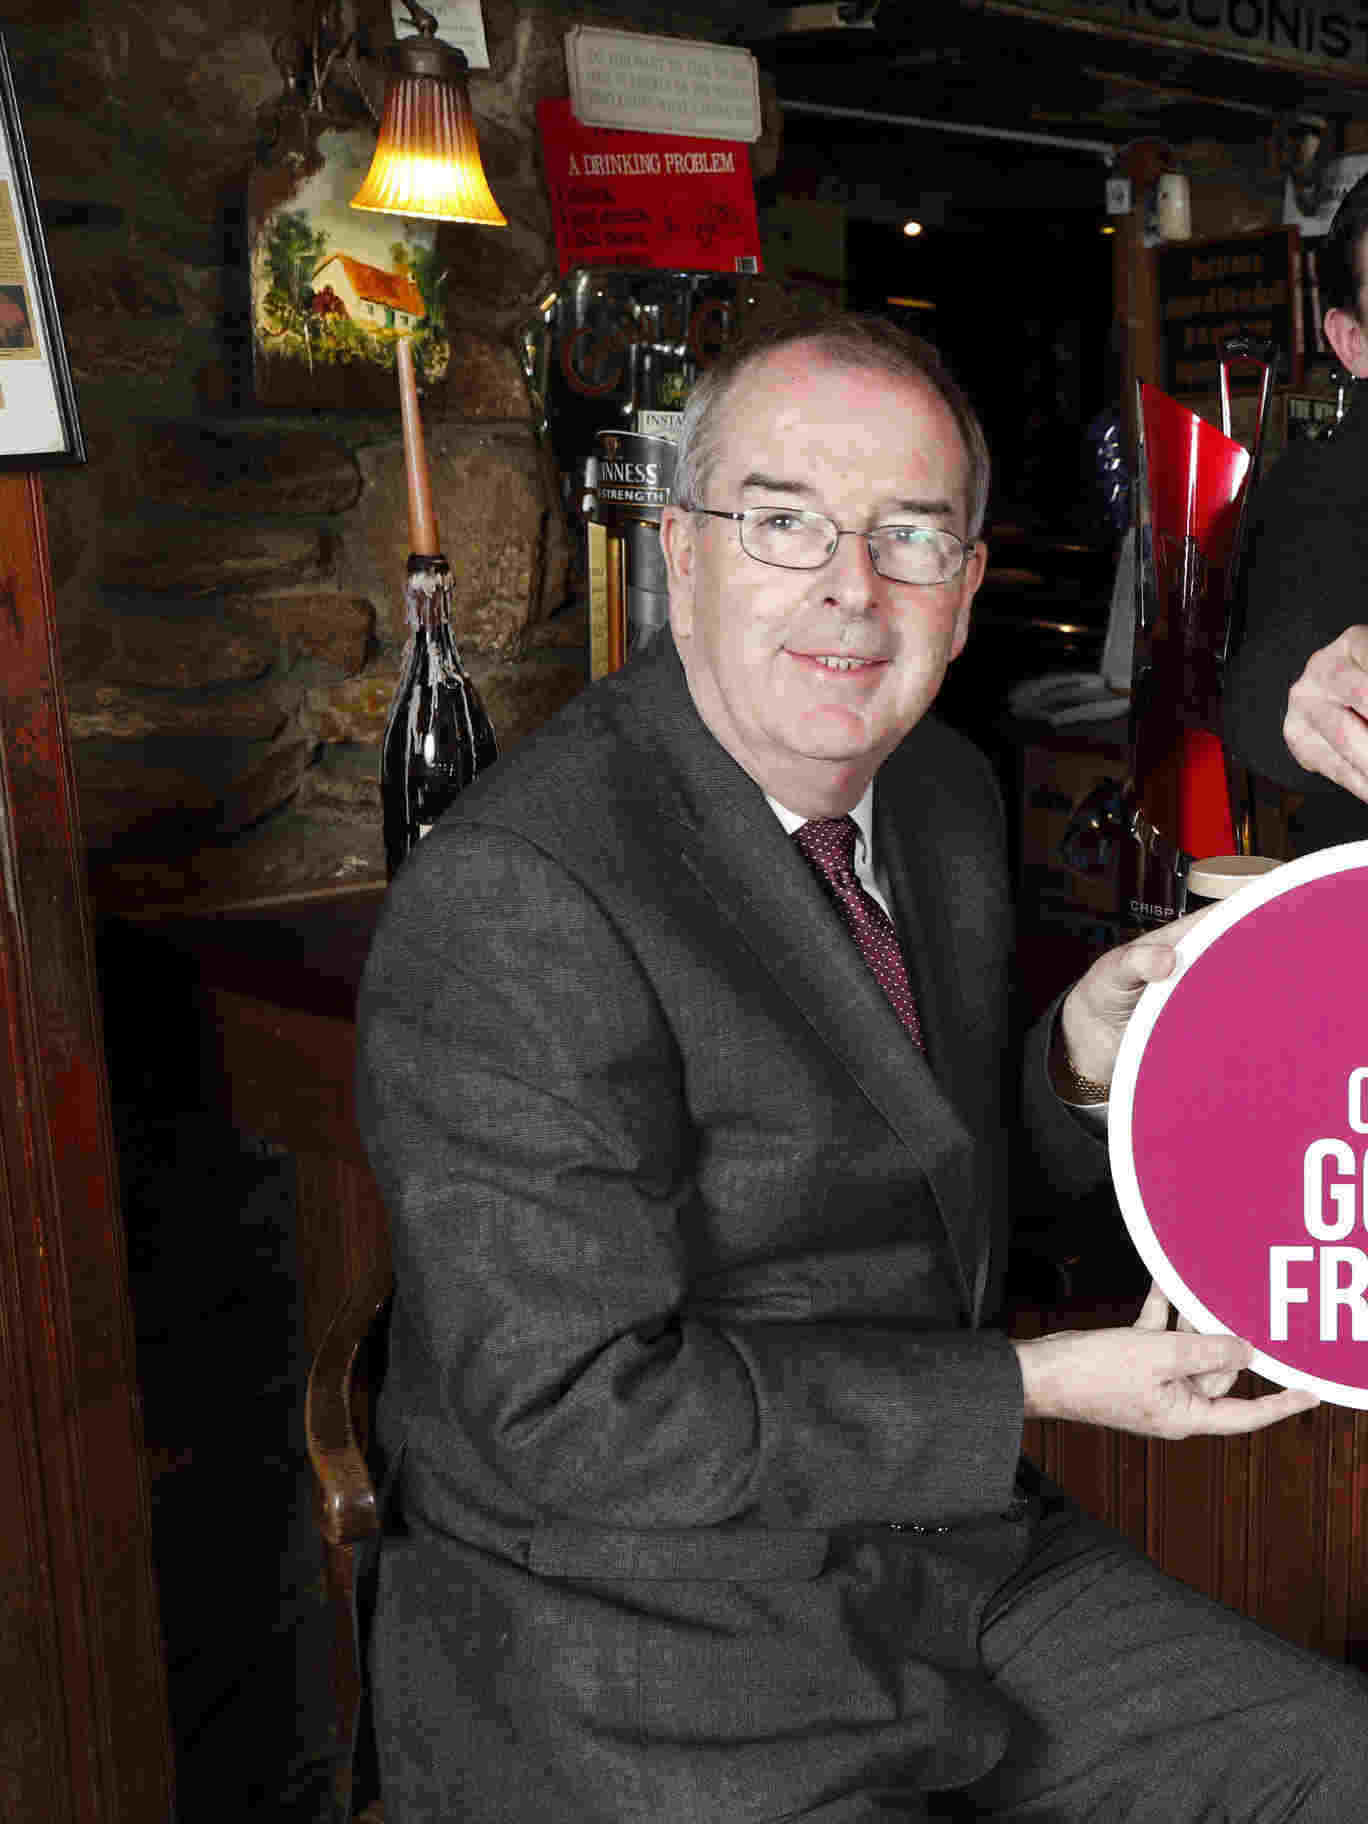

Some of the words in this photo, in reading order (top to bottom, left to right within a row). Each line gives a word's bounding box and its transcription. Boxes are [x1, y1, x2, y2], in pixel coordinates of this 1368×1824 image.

[569, 153, 580, 175] A
[583, 153, 661, 176] DRINKING
[664, 151, 736, 174] PROBLEM
[1130, 900, 1175, 917] CRISP
